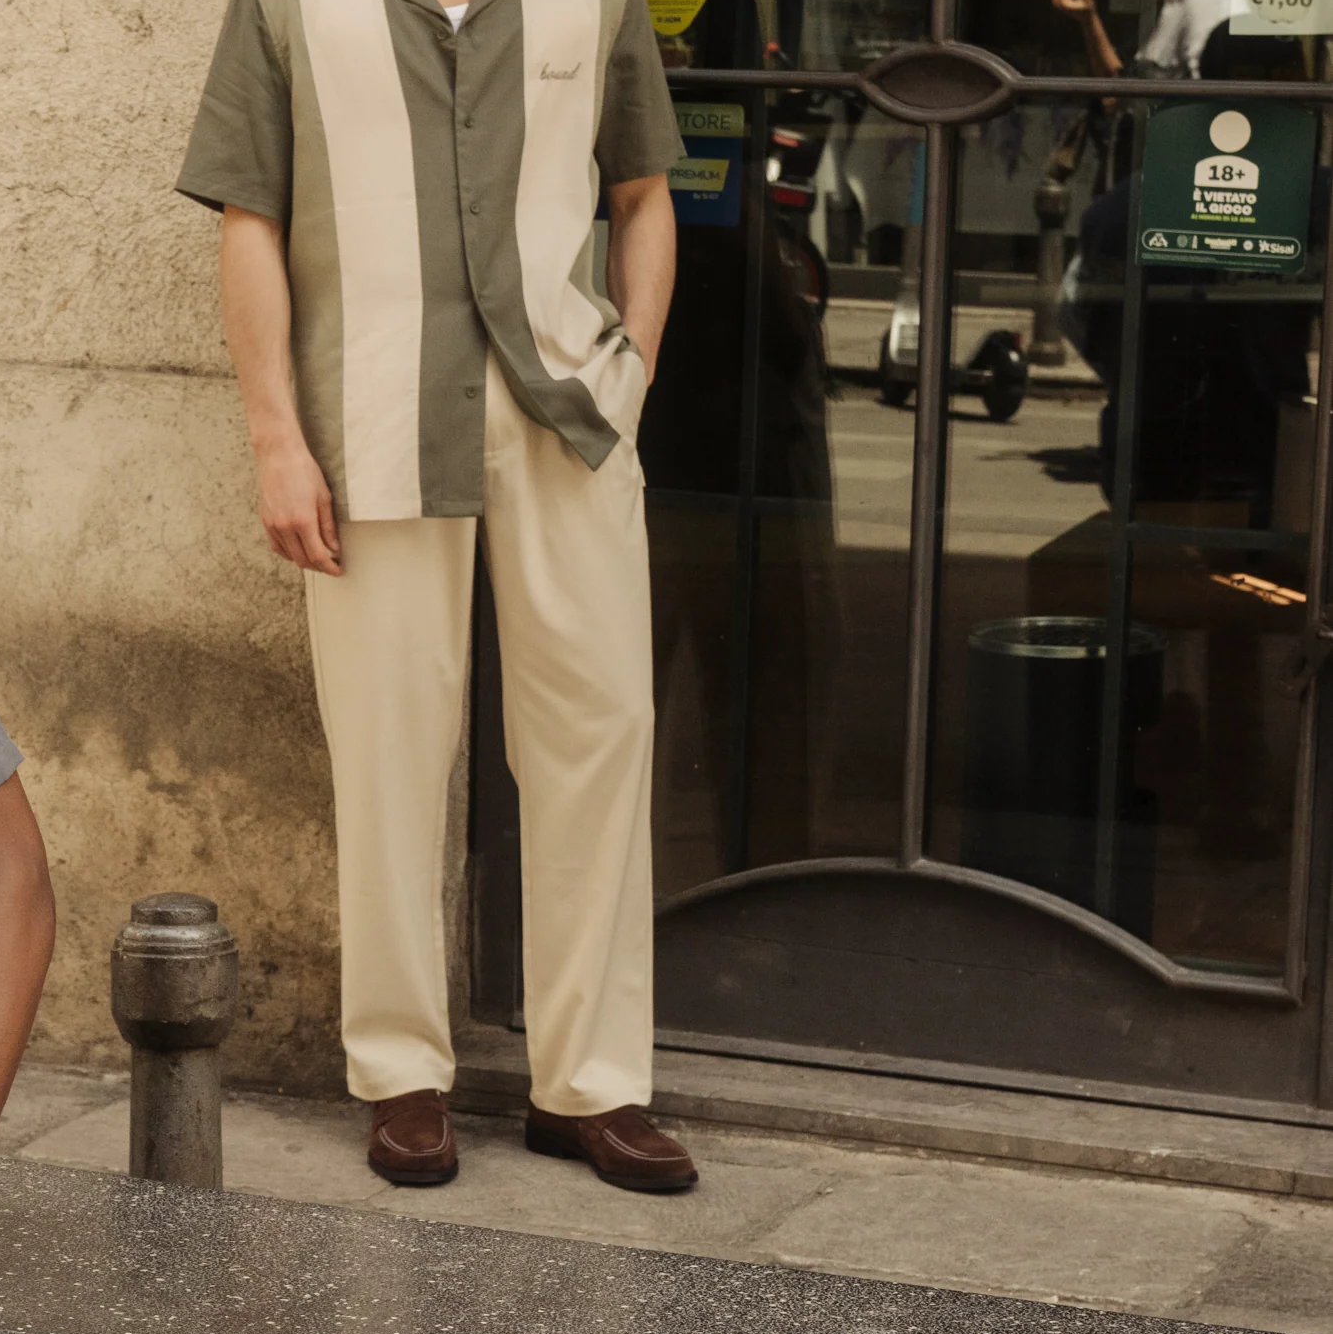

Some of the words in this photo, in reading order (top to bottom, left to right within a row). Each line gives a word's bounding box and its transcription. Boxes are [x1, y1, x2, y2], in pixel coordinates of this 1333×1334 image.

[676, 113, 731, 130] TORE
[670, 168, 721, 181] PREMIUM
[1208, 165, 1246, 182] 18+
[1203, 191, 1257, 205] VIETATO
[1195, 203, 1207, 213] IL
[1208, 203, 1253, 216] GIOCO
